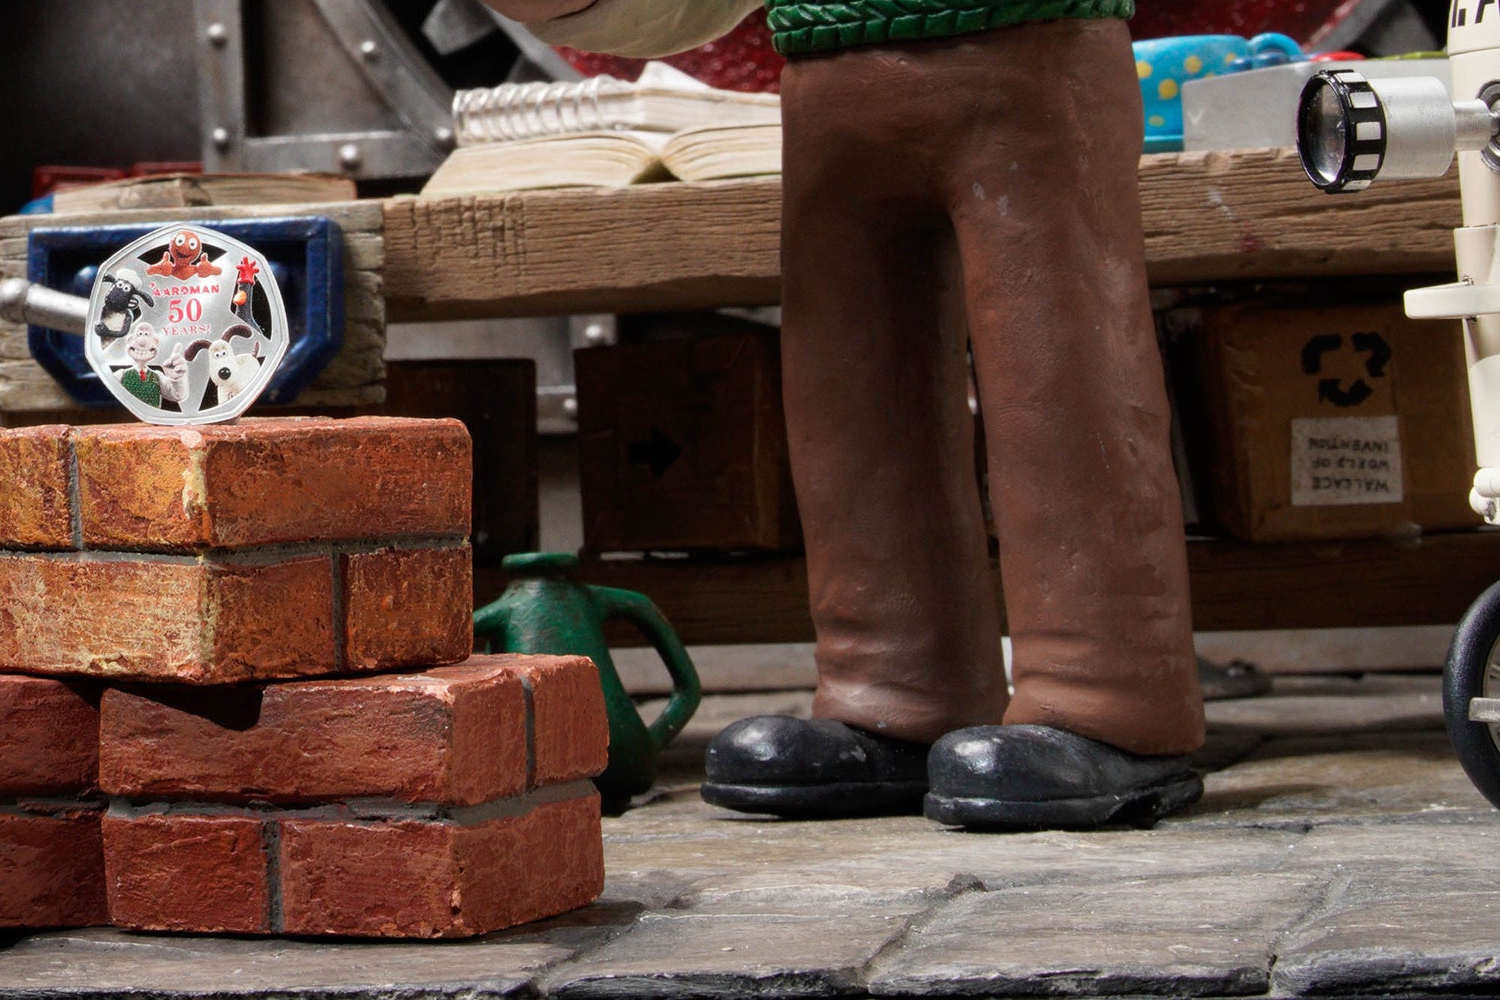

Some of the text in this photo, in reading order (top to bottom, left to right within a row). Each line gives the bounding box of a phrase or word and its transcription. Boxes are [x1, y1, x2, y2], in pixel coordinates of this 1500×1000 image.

[168, 298, 202, 323] 50
[163, 325, 210, 336] YEARS!
[1311, 458, 1331, 469] OF
[1312, 477, 1389, 493] WALLACE
